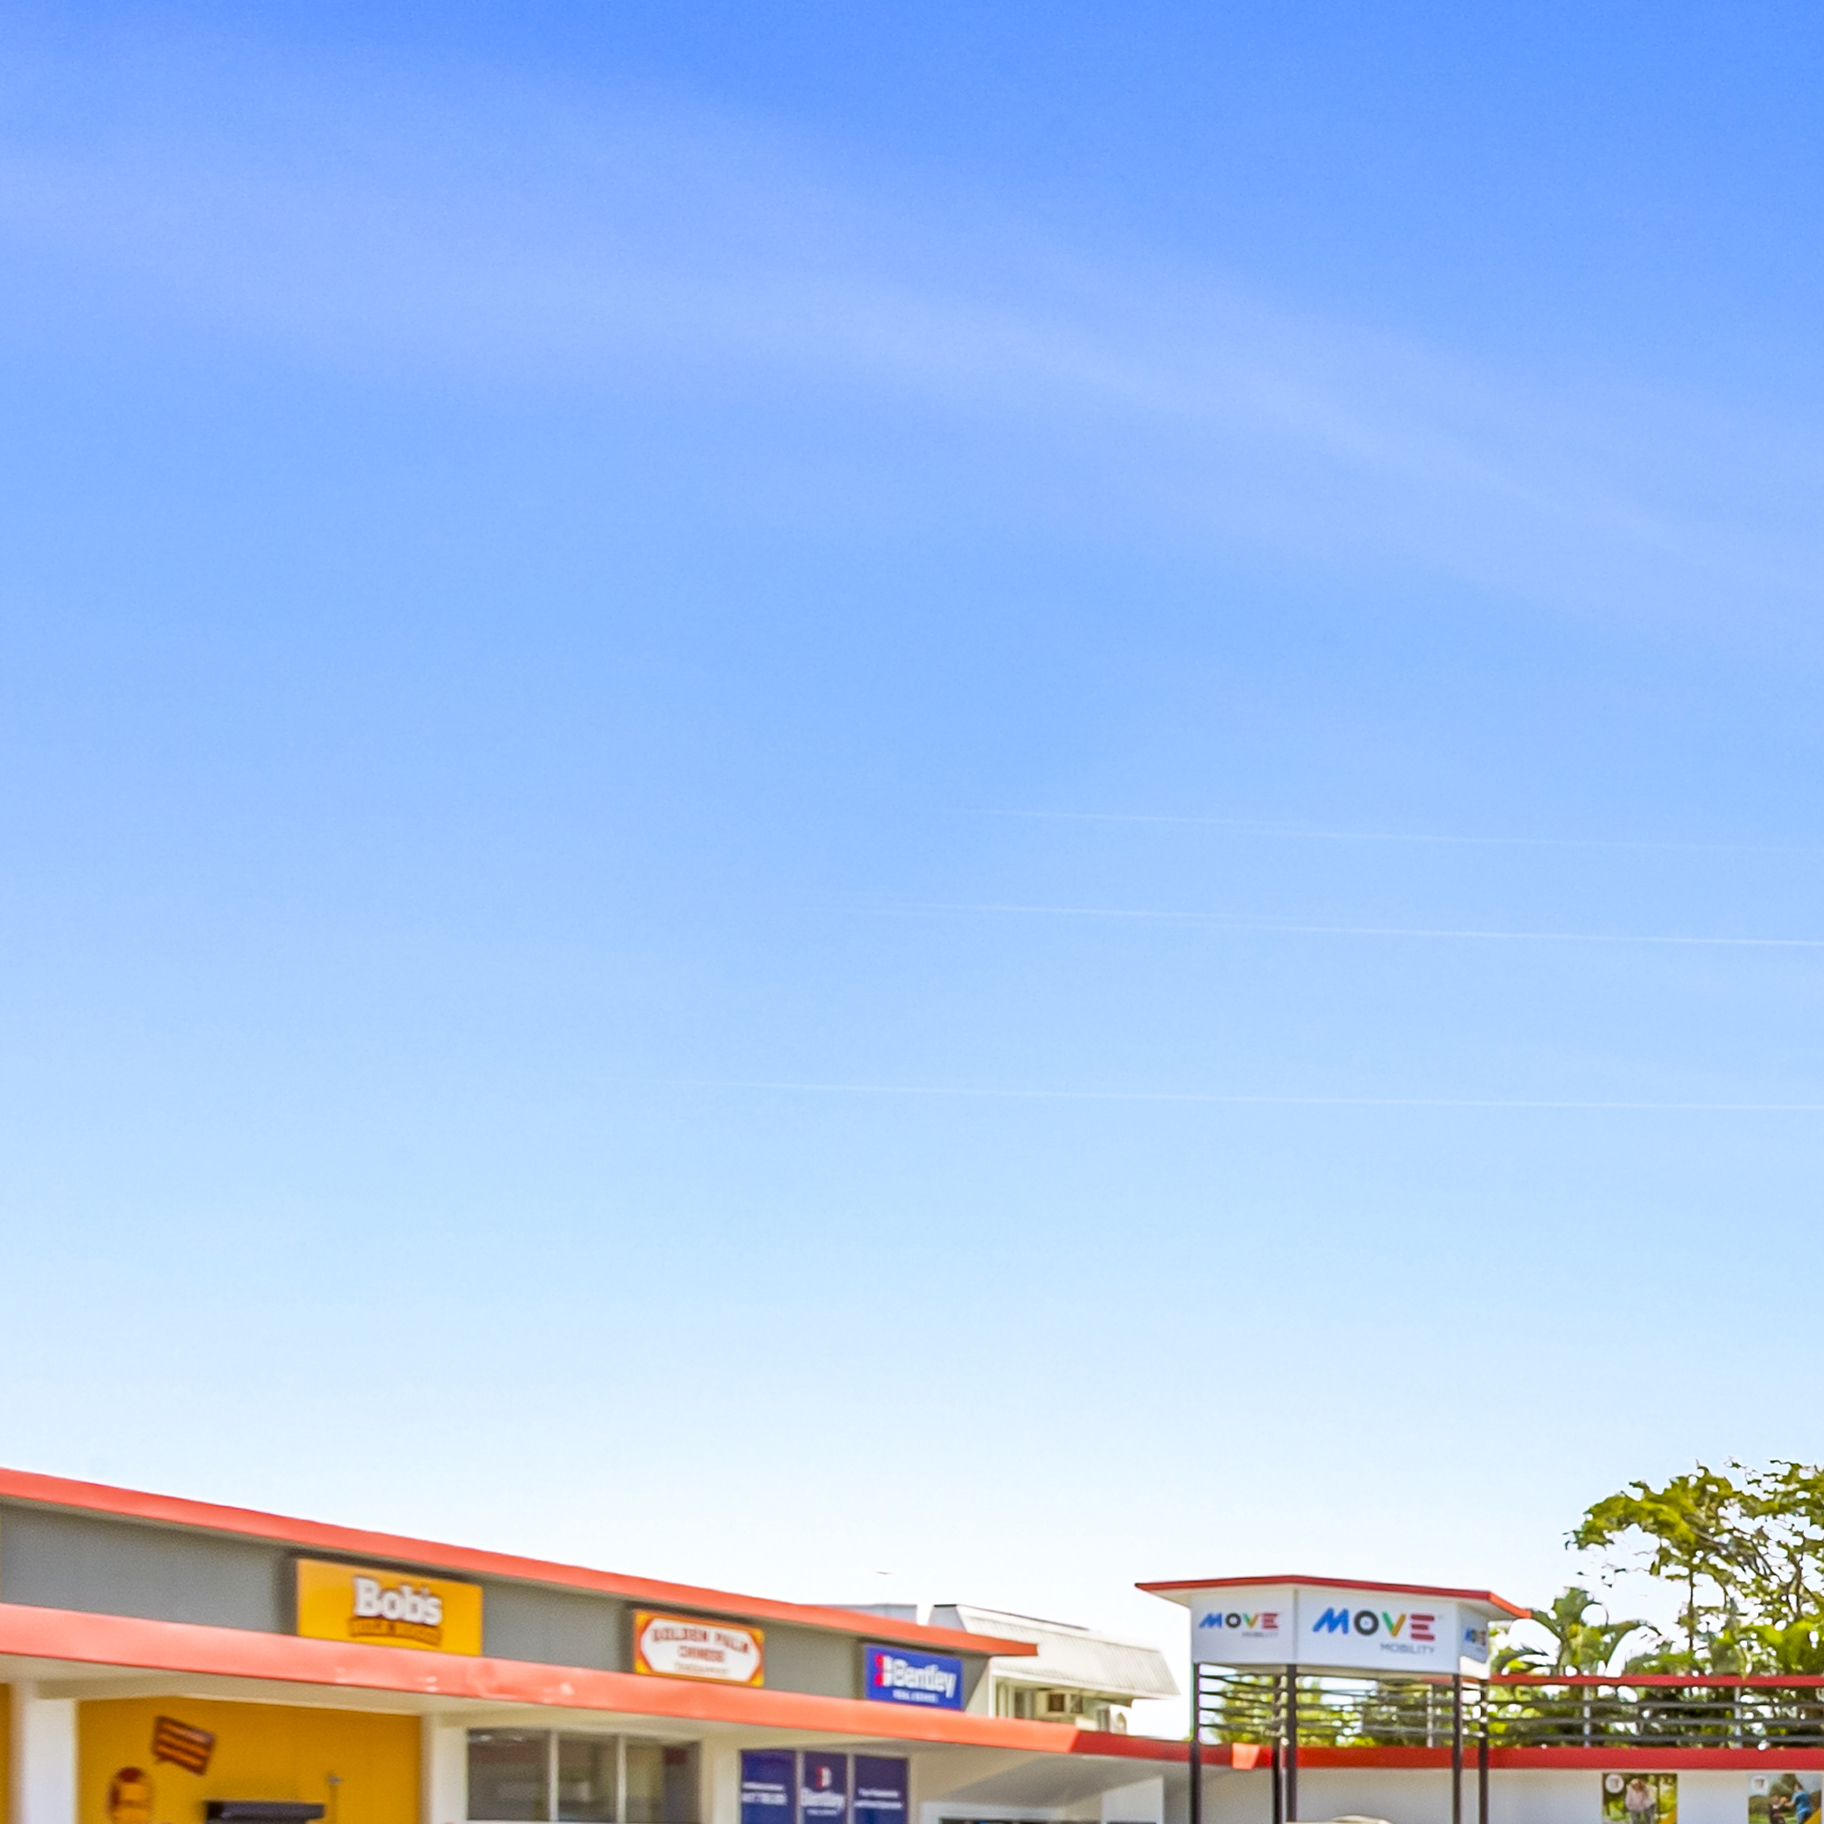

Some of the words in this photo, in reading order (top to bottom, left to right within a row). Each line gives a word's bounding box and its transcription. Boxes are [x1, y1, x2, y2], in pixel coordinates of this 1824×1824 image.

[354, 1577, 442, 1627] Bob's
[1199, 1612, 1279, 1629] MOVE
[1312, 1607, 1436, 1642] MOVE
[1380, 1643, 1436, 1655] MOBILITY
[893, 1659, 957, 1699] Bentley
